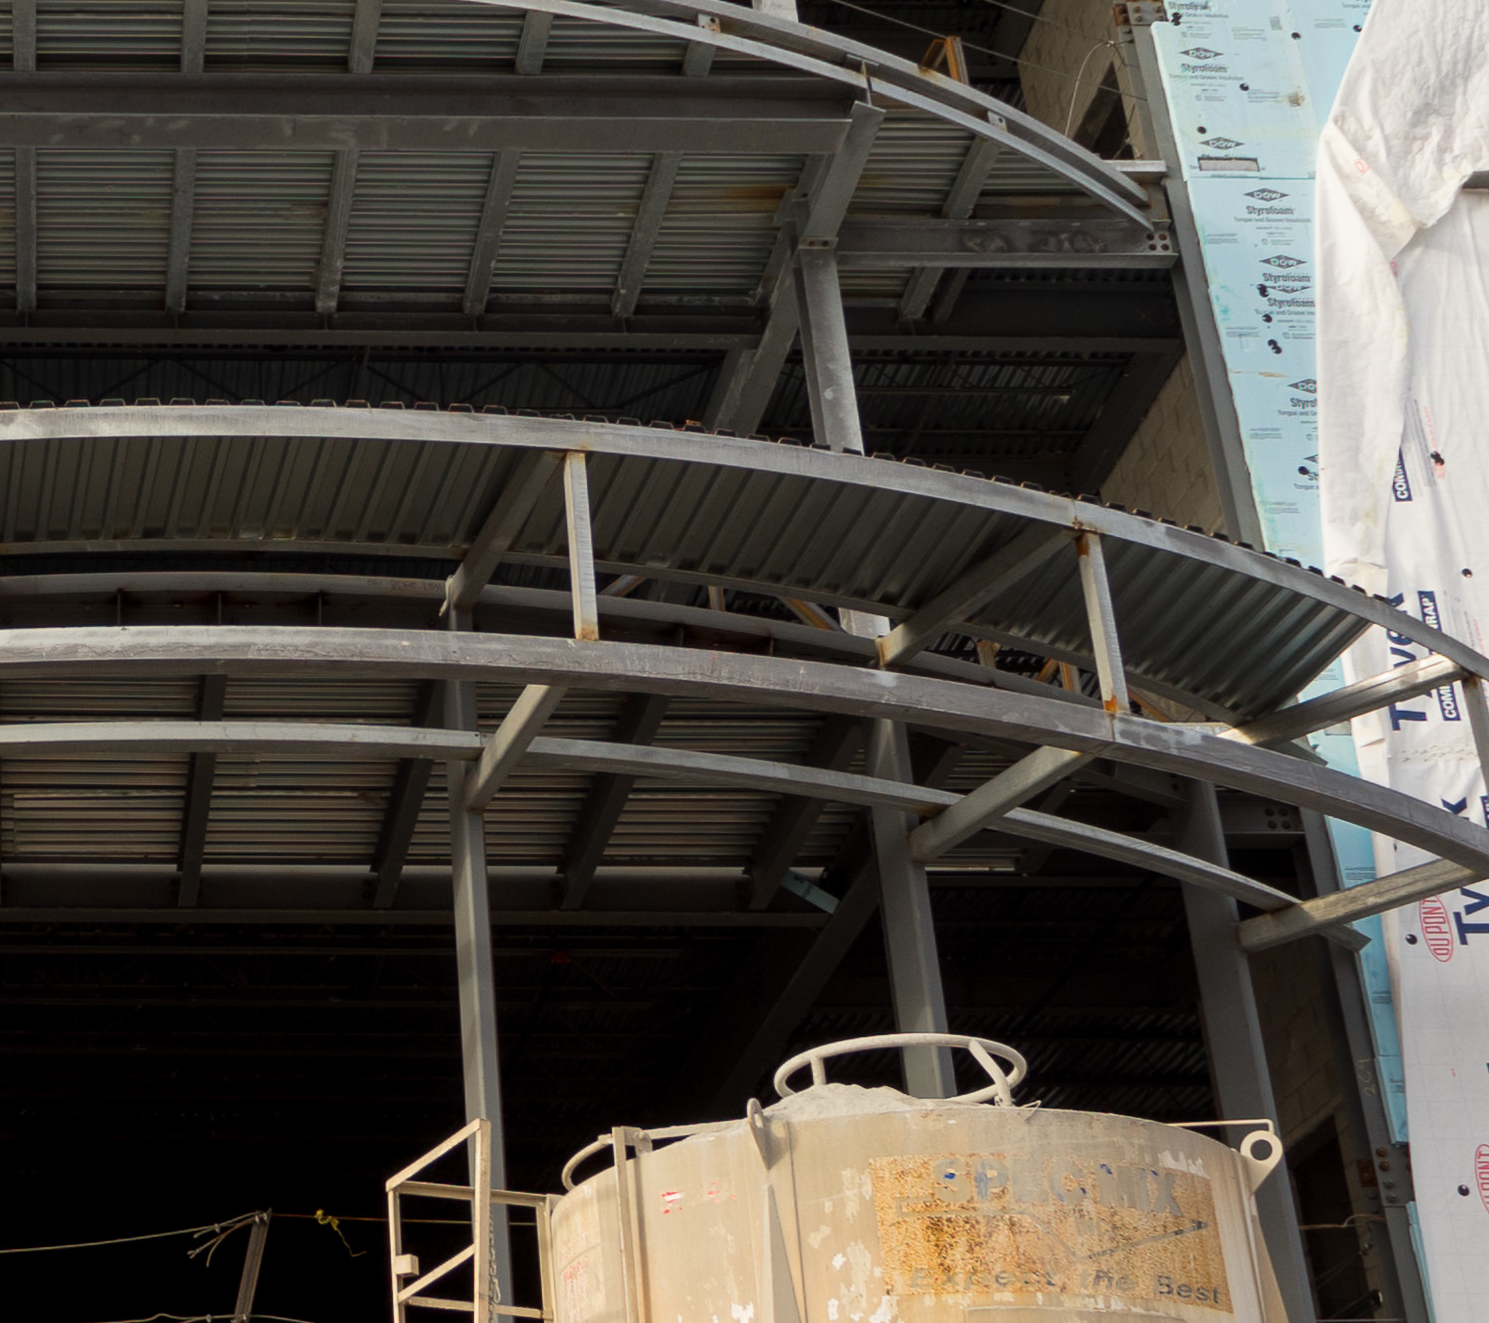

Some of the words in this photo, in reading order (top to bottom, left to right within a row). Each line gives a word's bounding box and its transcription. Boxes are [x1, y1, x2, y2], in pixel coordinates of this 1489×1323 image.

[1181, 63, 1228, 73] Styrofoam
[1246, 206, 1294, 216] Styrofoam
[1152, 1275, 1221, 1305] Best
